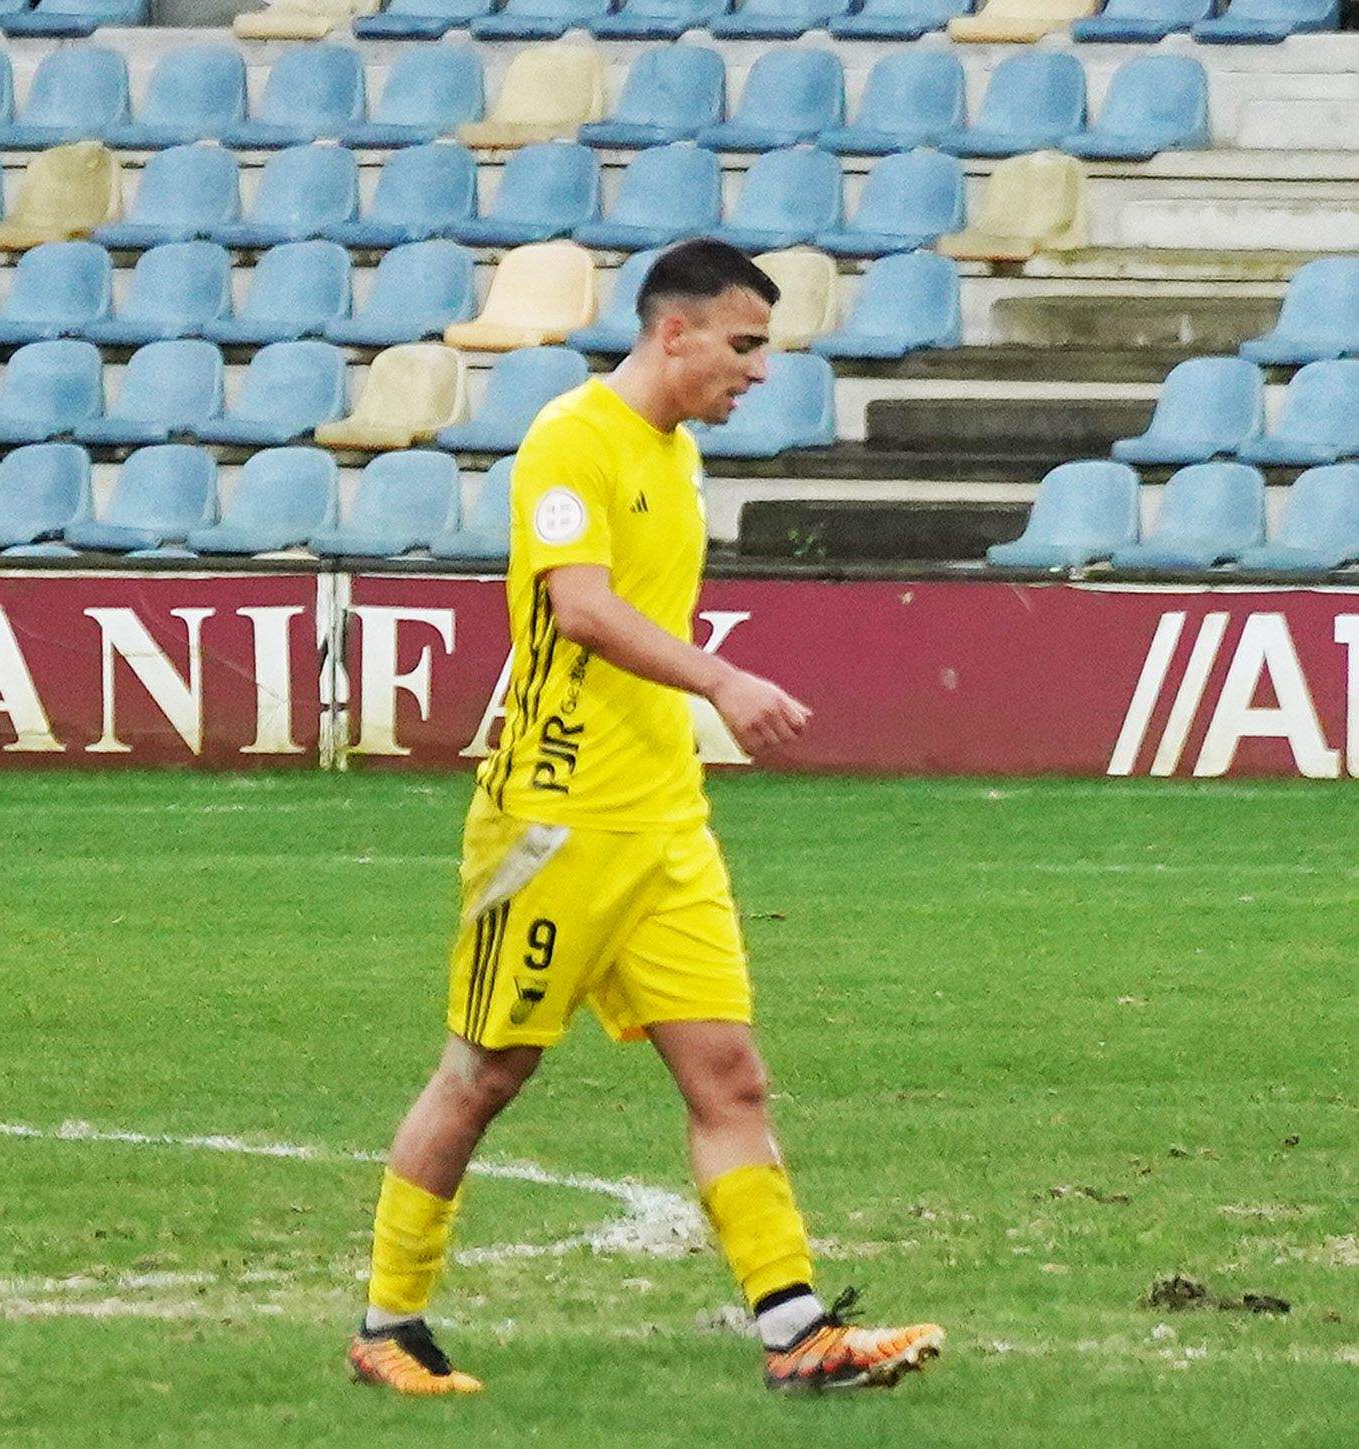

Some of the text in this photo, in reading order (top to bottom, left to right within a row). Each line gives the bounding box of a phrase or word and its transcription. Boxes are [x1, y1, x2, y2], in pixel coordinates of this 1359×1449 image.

[1193, 611, 1359, 779] A
[531, 715, 585, 795] PJR
[523, 918, 558, 971] 9
